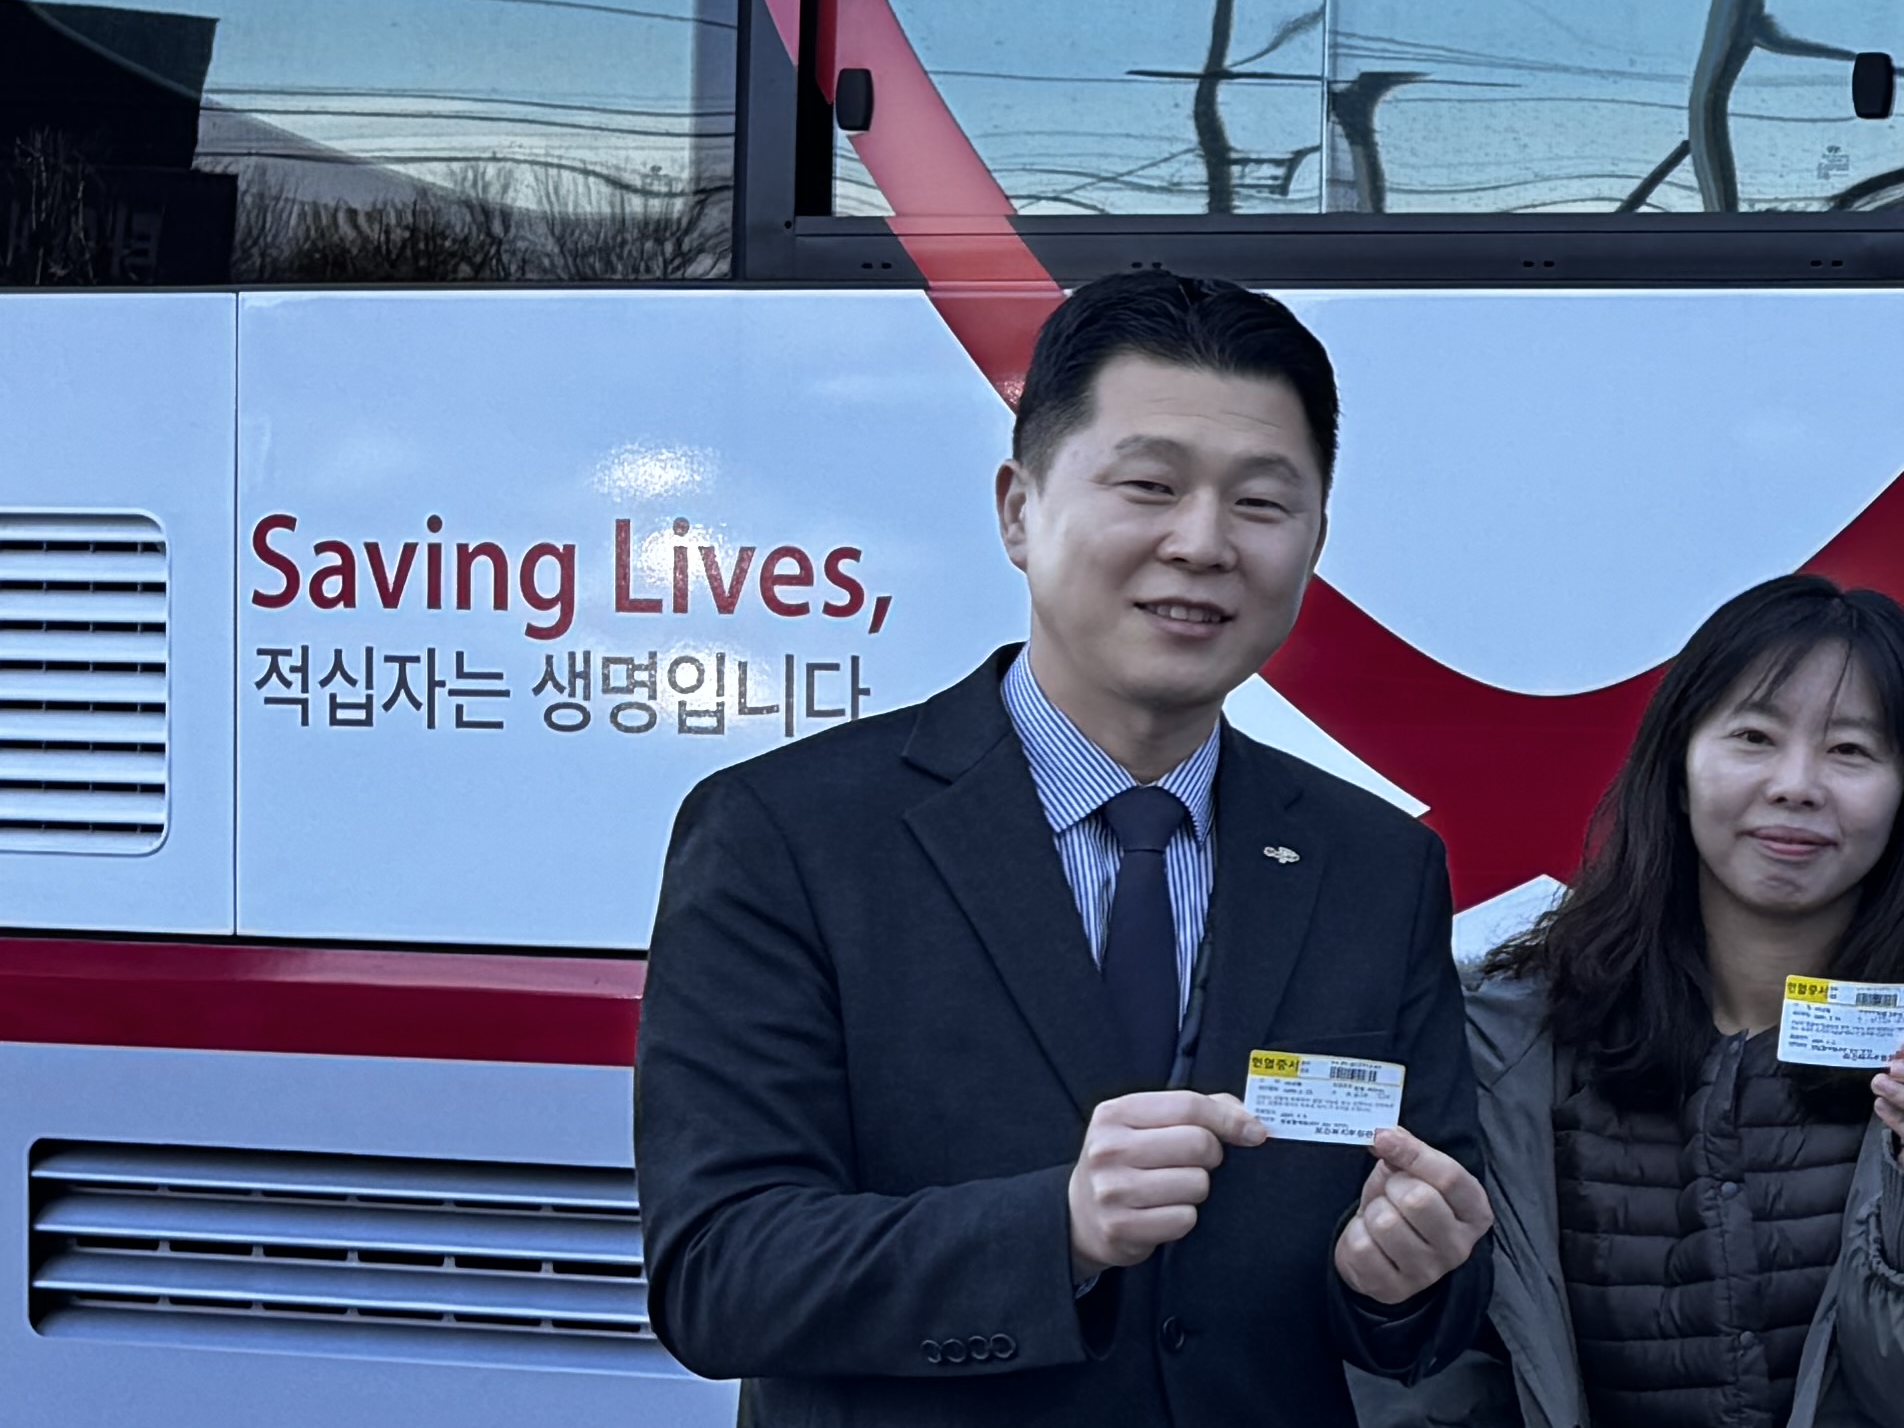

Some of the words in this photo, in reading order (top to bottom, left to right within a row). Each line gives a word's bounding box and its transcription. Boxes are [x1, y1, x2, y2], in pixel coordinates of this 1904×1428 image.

[251, 513, 576, 640] Saving
[614, 516, 893, 635] Lives,
[252, 644, 511, 730] 적십자는
[531, 648, 871, 737] 생명입니다
